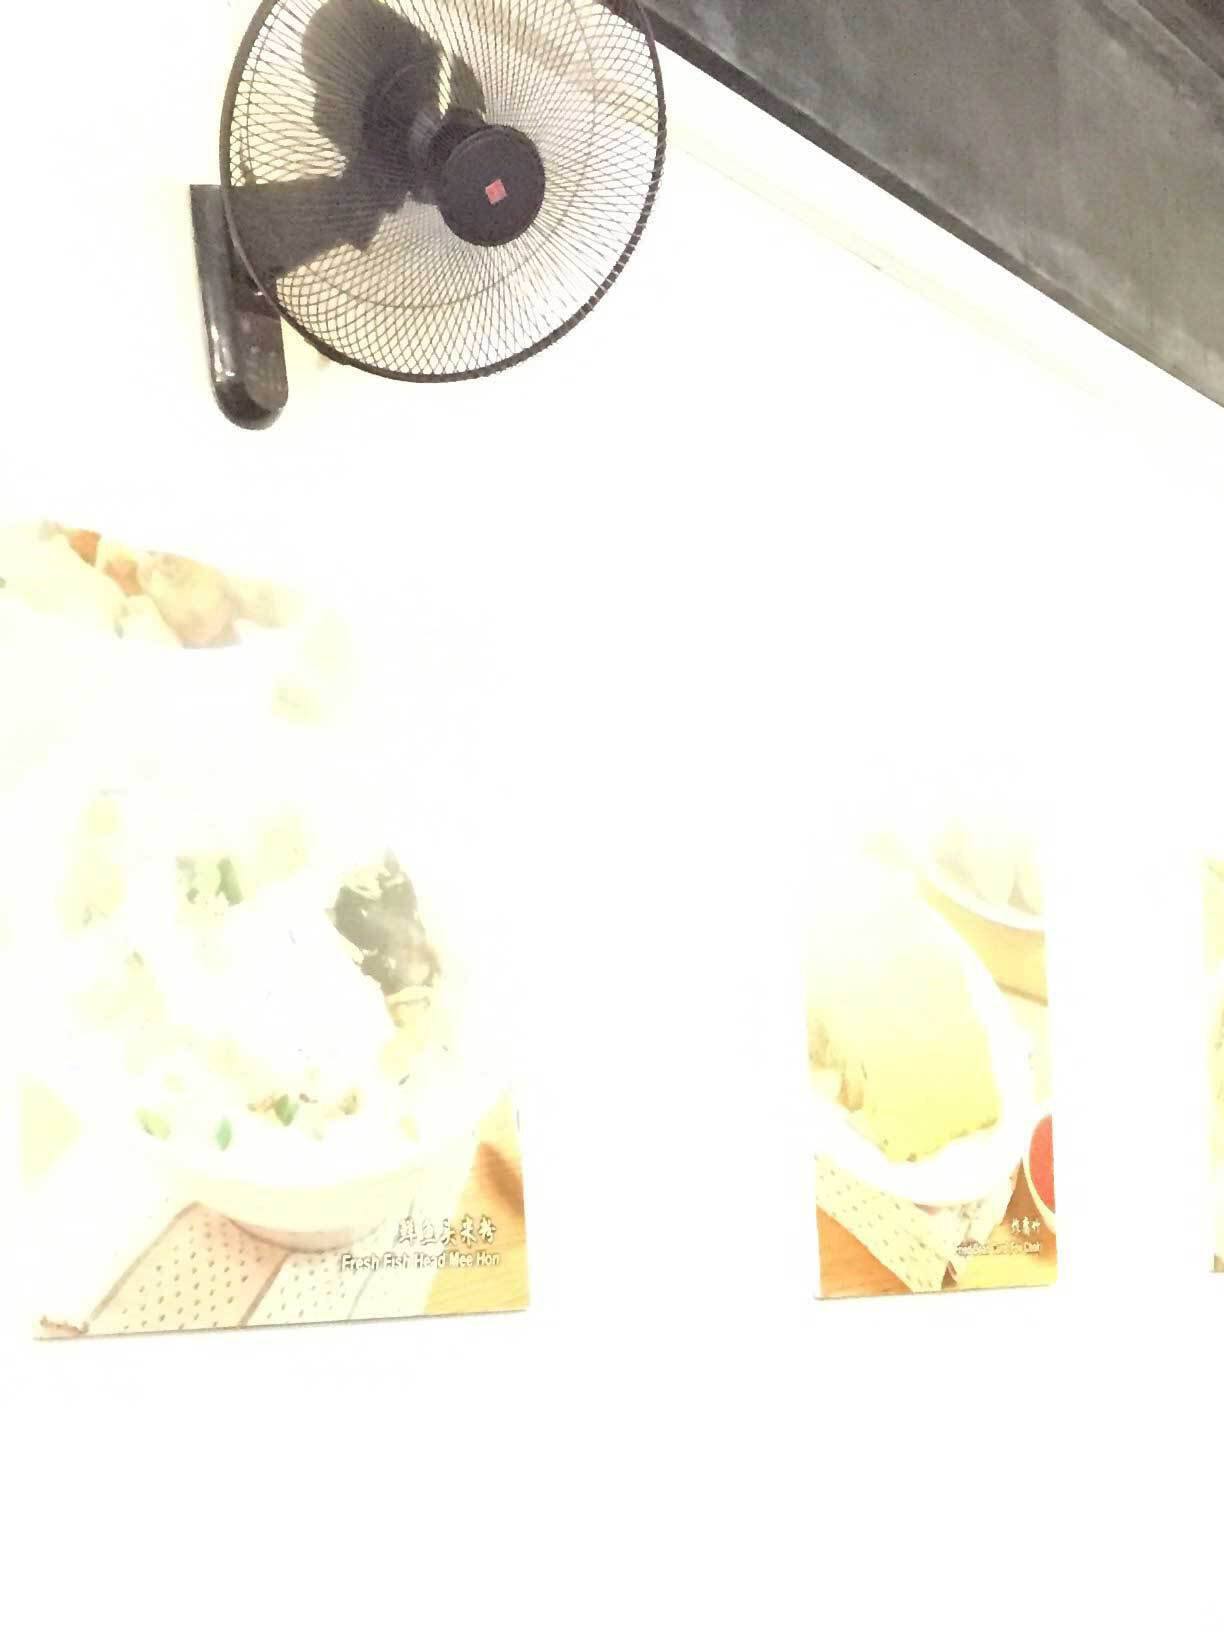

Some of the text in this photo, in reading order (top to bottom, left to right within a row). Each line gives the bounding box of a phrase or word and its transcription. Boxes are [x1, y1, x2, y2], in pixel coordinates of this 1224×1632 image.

[341, 1253, 379, 1273] Fresh
[383, 1252, 409, 1271] Fish
[415, 1251, 446, 1269] Head
[449, 1250, 473, 1268] Mee
